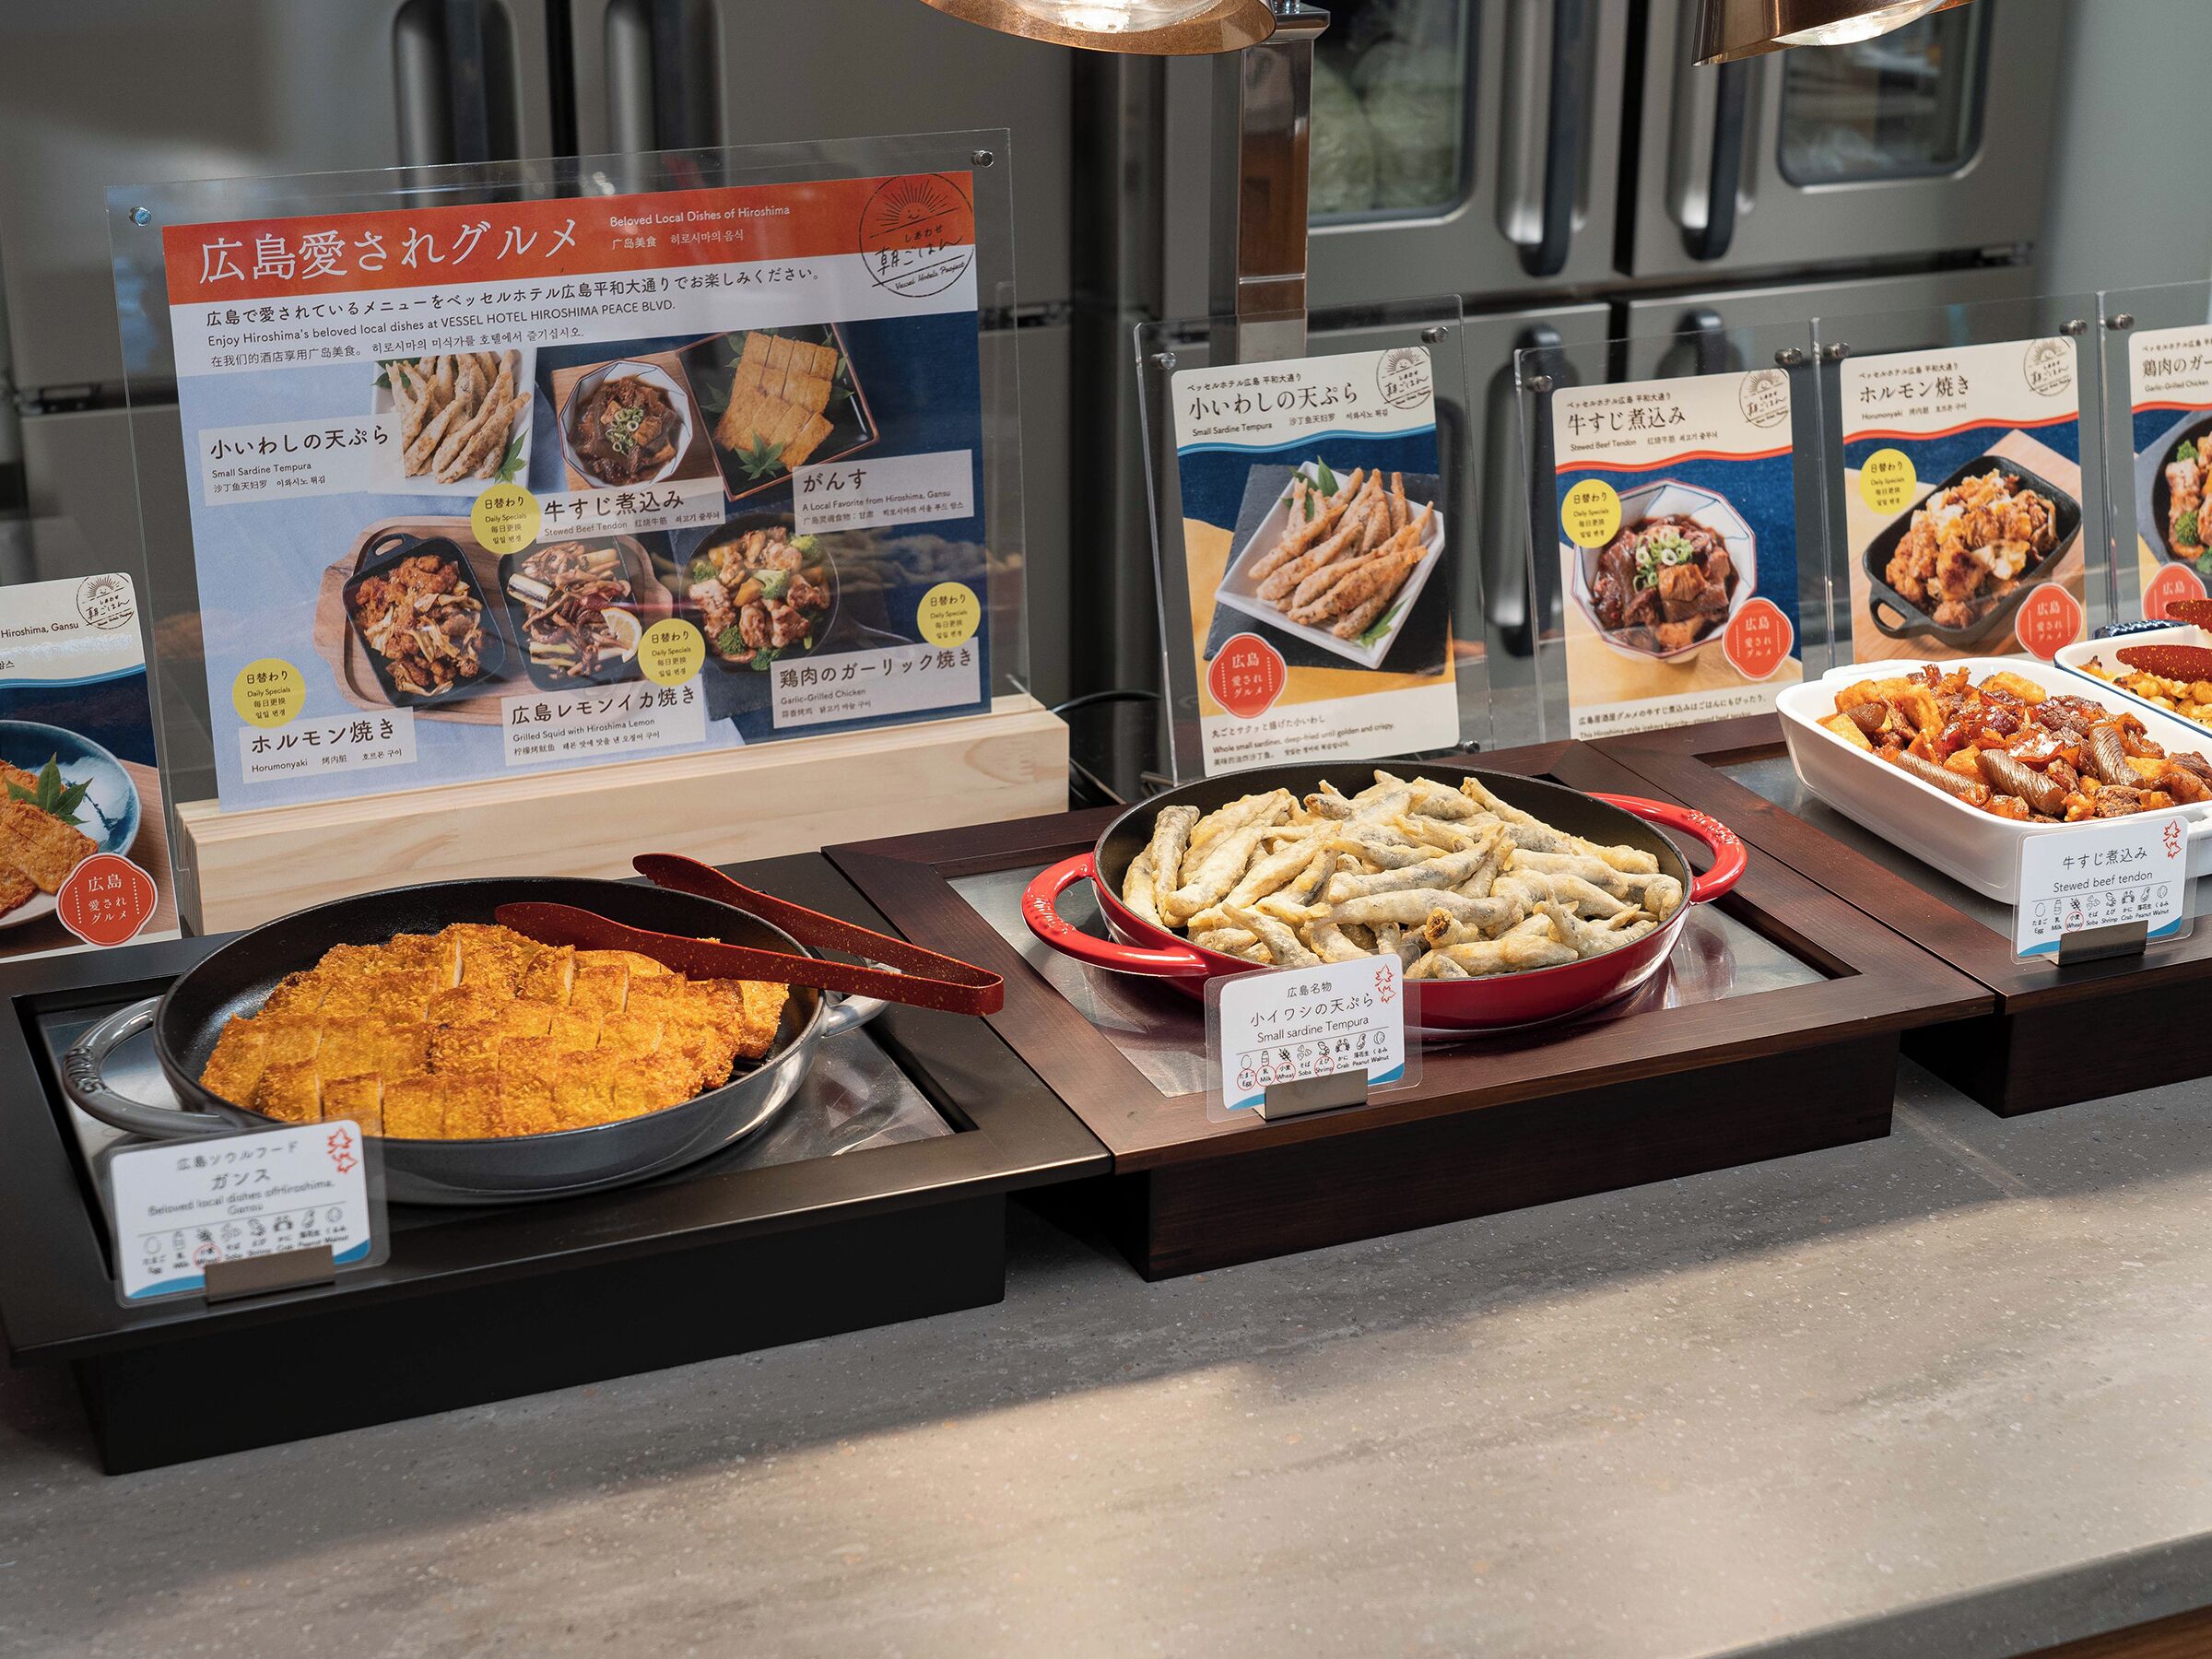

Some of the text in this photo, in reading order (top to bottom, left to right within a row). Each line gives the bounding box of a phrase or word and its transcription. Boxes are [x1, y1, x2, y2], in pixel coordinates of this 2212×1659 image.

[610, 205, 790, 228] Beloved Local Dishes of Hiroshima
[612, 236, 657, 251] 广岛美食
[670, 229, 744, 245] 히로시마의 음식
[199, 218, 576, 285] 広島愛されグルメ
[206, 267, 818, 326] 広島で愛されているメニューをベッセルホテル広島平和大通りでお楽しみください。
[207, 300, 676, 347] Enjoy Hiroshima's beloved local dishes at VESSEL HOTEL HIROSHIMA PEACE BLVD.
[372, 327, 584, 354] 히로시마의 미식가를 호텔에서 즐기십시오.
[210, 344, 361, 368] 在我们的酒店享用广岛美食。
[1187, 373, 1301, 392] ベッセルホテル広島 平和大通り
[1860, 375, 1969, 403] ホルモン焼き
[1188, 382, 1359, 420] 小いわしの天ぷら
[1193, 421, 1273, 437] Small Sardine Tempura
[1567, 406, 1686, 436] 牛すじ煮込み
[210, 426, 388, 460] 小いわしの天ぷら
[1571, 439, 1637, 452] Stewed Beef Tendon
[212, 462, 312, 478] Small Sardine Tempura
[803, 468, 867, 493] がんす
[485, 496, 524, 510] 日替わり
[544, 490, 684, 523] 牛すじ煮込み
[802, 490, 951, 512] A Local Favorite from Hiroshima, Gansu
[1573, 492, 1606, 504] 日替わり
[502, 512, 526, 522] Specials
[544, 521, 628, 536] Stewed Beef Tendon
[2162, 581, 2185, 595] 広島
[931, 594, 966, 606] 日替わり
[2037, 600, 2061, 617] 広島
[1, 622, 79, 639] Hiroshima, Gansu
[1745, 617, 1771, 631] 広島
[652, 630, 689, 643] 日替わり
[780, 648, 971, 688] 鶏肉のガーリック焼き
[1231, 652, 1260, 669] 広島
[246, 670, 288, 685] 日替わり
[1231, 674, 1263, 688] 愛され
[247, 687, 291, 699] Daily Specials
[781, 688, 866, 705] Garlic-Grilled Chicken
[1233, 686, 1263, 699] グルメ
[512, 686, 695, 725] 広島レモンイカ焼き
[252, 718, 394, 754] ホルモン焼き
[512, 718, 655, 743] Grilled Squid with Hiroshima Lemon
[1213, 745, 1234, 755] Whole
[1236, 742, 1253, 751] small
[1336, 727, 1359, 737] golden
[1361, 724, 1373, 733] and
[252, 759, 308, 773] Horumonyaki
[2062, 847, 2147, 870] 牛すじ煮込み
[88, 874, 122, 893] 広島
[2053, 871, 2153, 893] Stewed beef tendon
[88, 897, 127, 912] 愛され
[92, 910, 127, 925] グルメ
[2100, 916, 2118, 925] Shrimp
[2152, 908, 2170, 916] Walnut
[1287, 982, 1332, 998] 広島名物
[1250, 994, 1373, 1028] 小イワシの天ぷら
[1257, 1017, 1369, 1043] Small sardine Tempura
[1314, 1065, 1334, 1074] Shrimp
[211, 1168, 271, 1191] ガンス
[228, 1203, 264, 1217] Gansu
